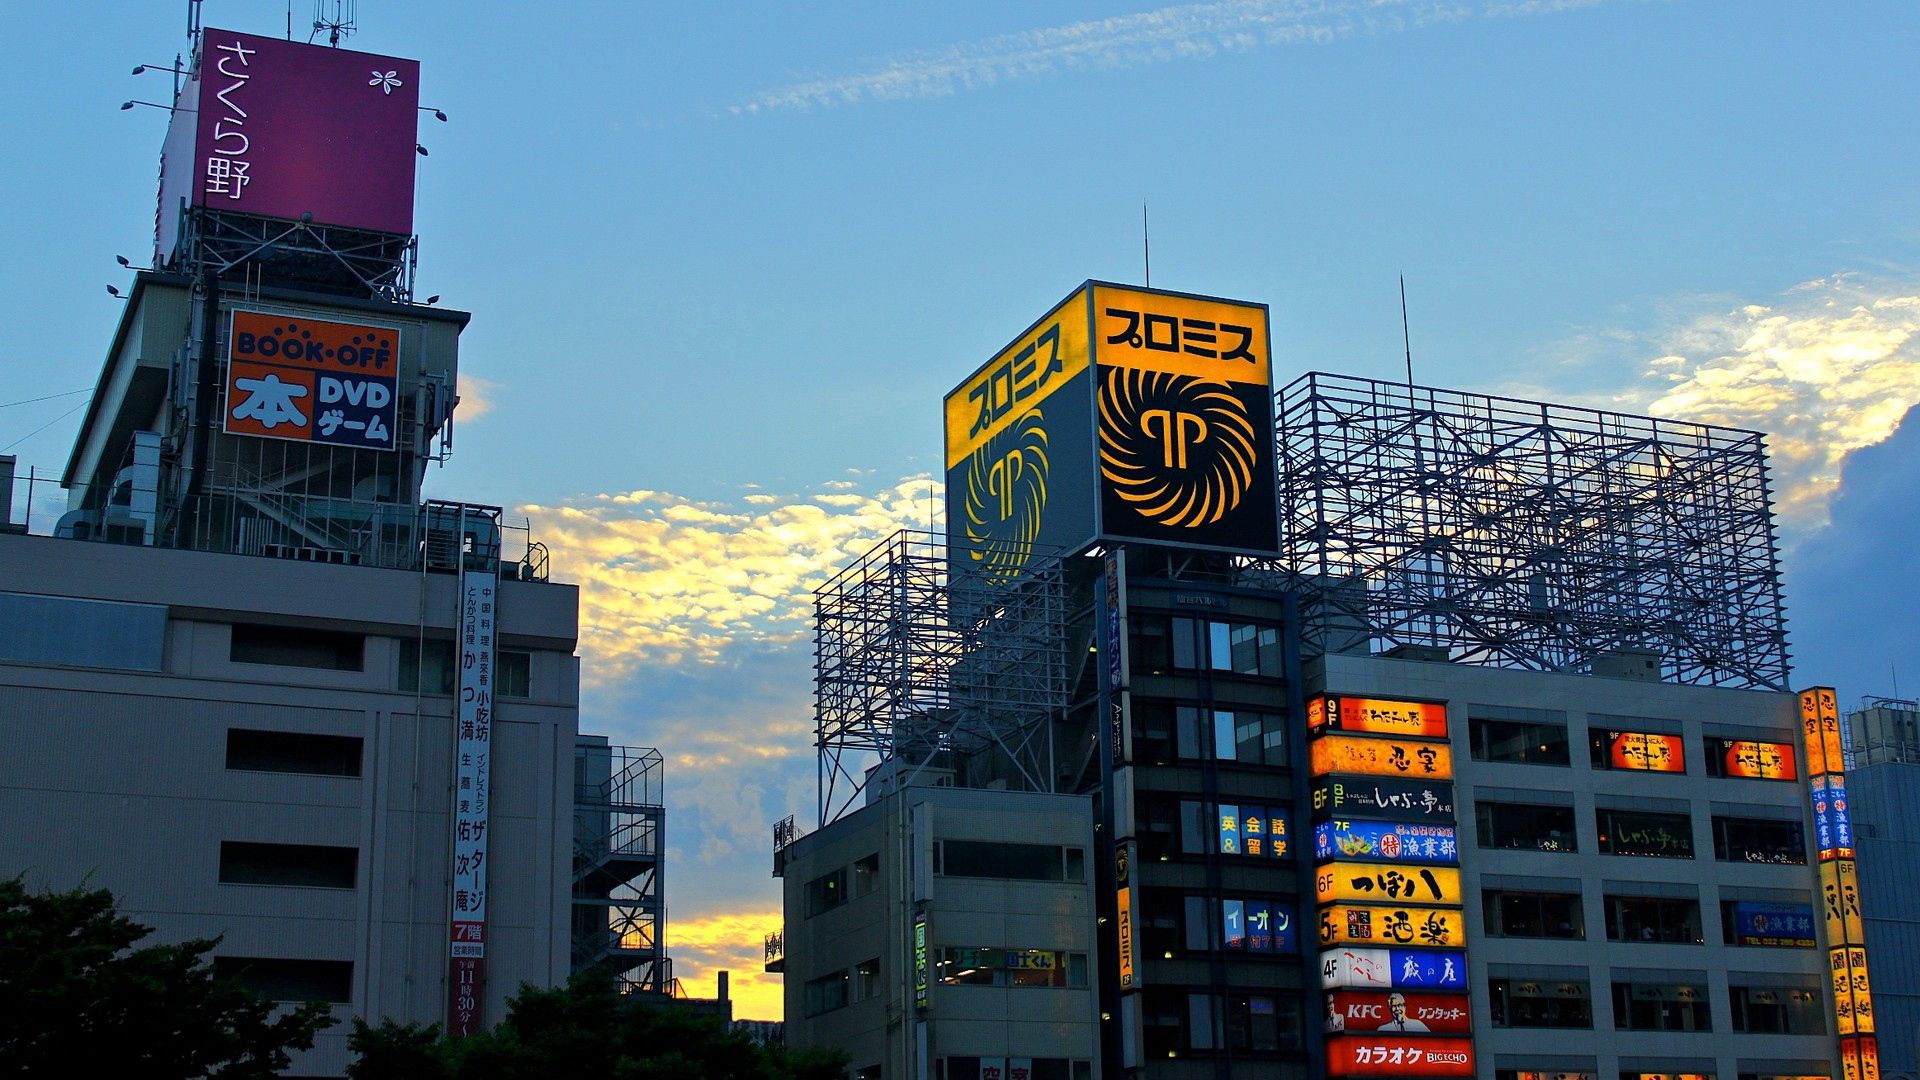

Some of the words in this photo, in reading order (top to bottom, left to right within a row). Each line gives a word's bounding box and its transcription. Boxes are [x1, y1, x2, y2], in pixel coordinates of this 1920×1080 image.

[206, 40, 256, 199] さくら野
[1106, 308, 1256, 364] プロミス
[969, 323, 1063, 440] プロミス
[232, 374, 307, 429] 本
[318, 377, 391, 409] DVD
[318, 409, 390, 442] ゲーム
[464, 586, 477, 645] とんかつ料理
[480, 587, 492, 647] 中国料理
[1328, 700, 1337, 726] 9F
[1221, 815, 1286, 836] 英会話
[1334, 821, 1350, 831] 7F
[1821, 850, 1832, 859] 7F
[1840, 848, 1851, 857] 7F
[1840, 863, 1853, 874] 6F
[1318, 873, 1333, 893] 6F
[1350, 869, 1443, 900] つぼ八
[1228, 909, 1289, 931] イーオン
[1320, 911, 1338, 942] 5F
[455, 924, 482, 940] 7階
[1120, 910, 1131, 969] プロミス
[1323, 959, 1337, 979] 4F
[1347, 1004, 1383, 1019] KFC
[1417, 1006, 1466, 1020] ケンタッキー
[1356, 1046, 1423, 1065] カラオケ
[1427, 1053, 1443, 1063] BIG
[1443, 1053, 1468, 1064] ECHO
